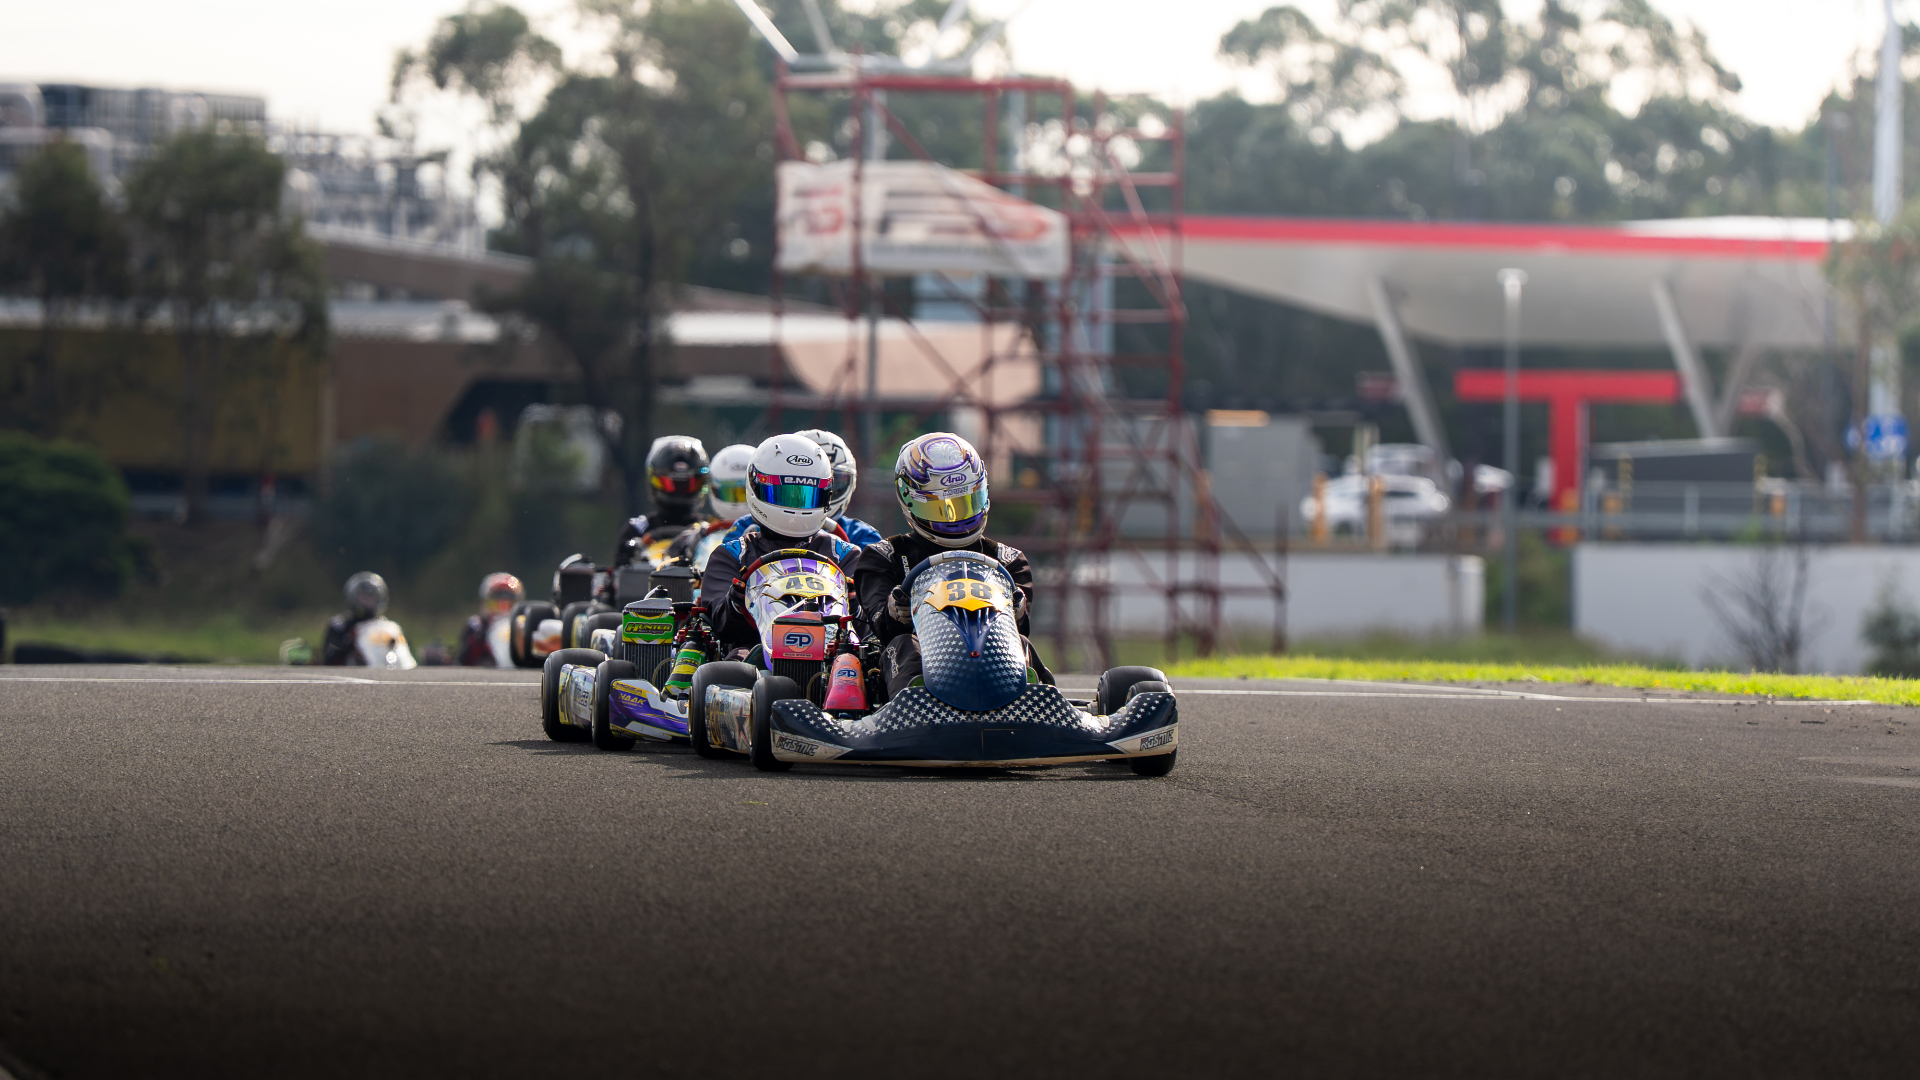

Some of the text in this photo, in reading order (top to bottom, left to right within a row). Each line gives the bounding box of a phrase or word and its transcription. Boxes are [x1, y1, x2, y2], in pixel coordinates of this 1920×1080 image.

[786, 577, 825, 591] 46
[946, 581, 992, 601] 38
[626, 623, 671, 632] HUNTER
[618, 693, 647, 705] HAAK
